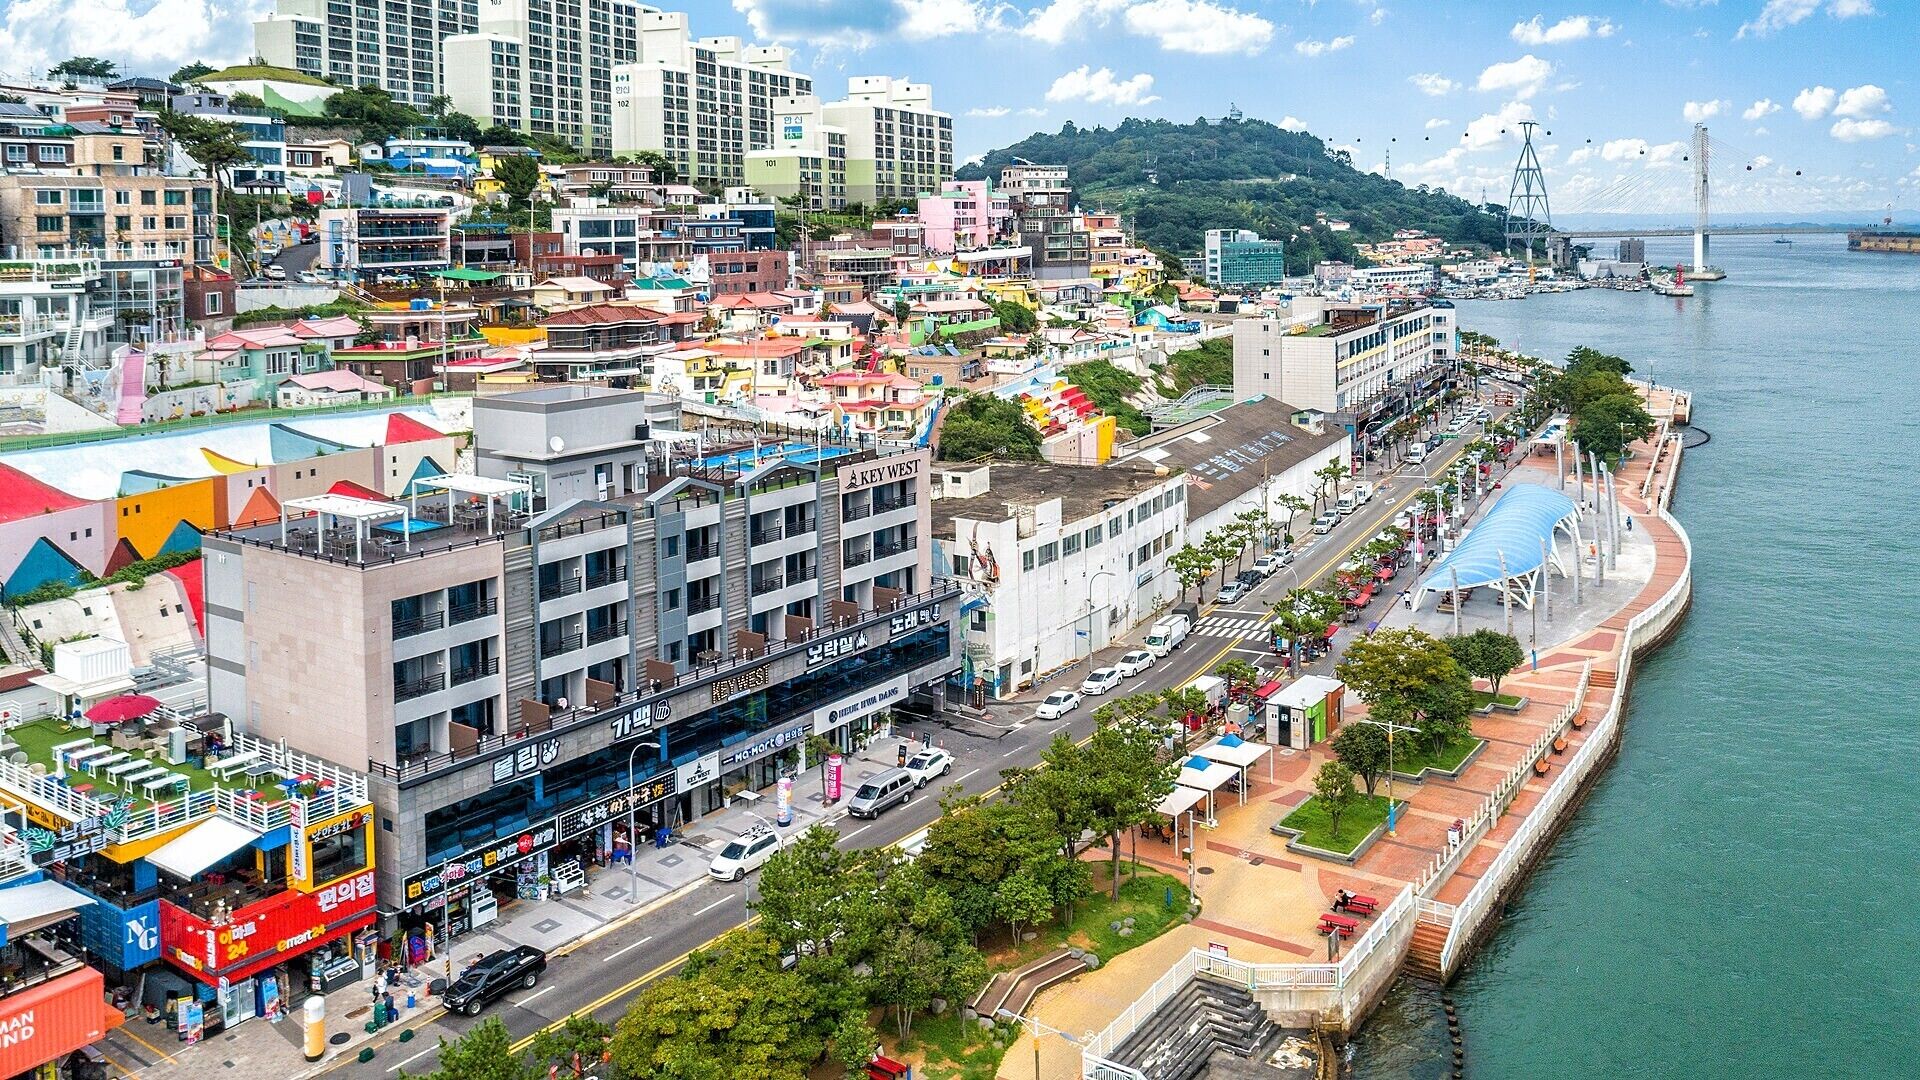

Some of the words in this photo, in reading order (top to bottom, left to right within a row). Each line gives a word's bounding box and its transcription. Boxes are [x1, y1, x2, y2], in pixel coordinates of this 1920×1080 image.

[615, 86, 630, 95] 한신
[617, 100, 630, 108] 102
[765, 159, 777, 168] 101
[860, 466, 885, 486] KEY
[887, 459, 921, 479] WEST
[891, 610, 918, 635] 노래
[807, 636, 854, 666] 오락실
[839, 703, 860, 718] HEUK
[861, 696, 877, 709] HWA
[879, 686, 899, 702] DANG
[611, 704, 652, 739] 가맥
[493, 743, 538, 783] 볼링
[318, 872, 375, 912] 편의점
[126, 915, 158, 951] NG
[219, 921, 257, 945] 이마트
[276, 923, 327, 952] emart24
[227, 940, 249, 960] 24
